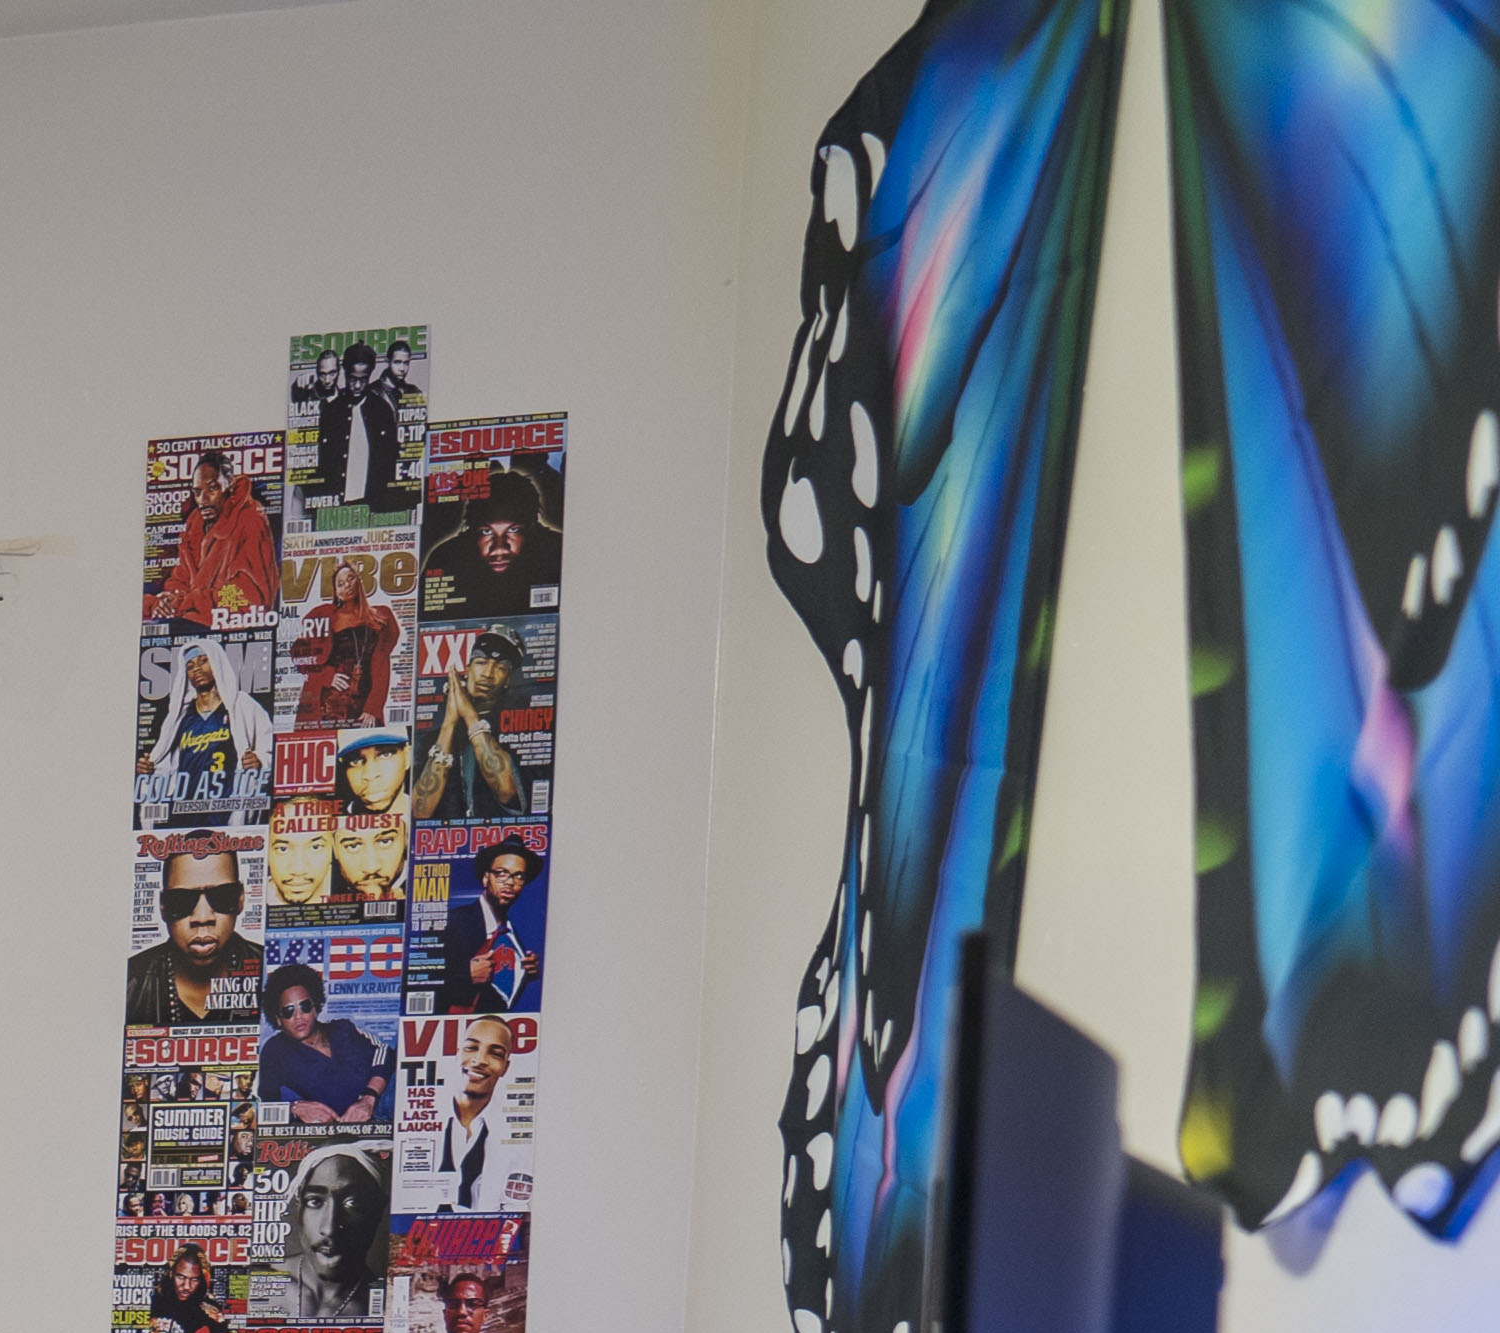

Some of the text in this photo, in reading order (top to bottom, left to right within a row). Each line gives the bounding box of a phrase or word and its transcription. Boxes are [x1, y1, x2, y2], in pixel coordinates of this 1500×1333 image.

[288, 402, 320, 417] BLACK
[398, 408, 426, 423] TUPAC
[156, 434, 275, 455] 50 CENT TALKS GREASY
[397, 427, 426, 447] Q-TIP
[439, 422, 564, 455] SOURCE
[161, 446, 284, 482] SORCE
[396, 463, 425, 482] E-40
[428, 469, 491, 490] KRS-ONE
[146, 490, 191, 505] SNOOP
[146, 502, 182, 516] DOGG
[316, 504, 371, 530] UNDER
[283, 530, 417, 551] SIXTH ANNIVERSARY JUICE ISSUE
[210, 605, 279, 631] Radio
[228, 630, 274, 643] NASH WADE
[500, 708, 555, 732] CHINGY
[180, 728, 231, 753] Nuggets
[210, 752, 226, 772] 3
[274, 740, 336, 786] HHC
[134, 768, 273, 805] COLD AS ICE
[173, 797, 269, 814] IVERSON STARTS FRESH
[274, 799, 344, 818] A TRIBE
[273, 813, 404, 835] CALLED QUEST
[415, 826, 468, 855] RAP
[413, 863, 451, 878] METHOD
[412, 877, 450, 902] MAN
[210, 976, 261, 994] KING OF
[328, 980, 402, 996] LENNY KRAVITZ
[204, 993, 259, 1011] AMERICA
[134, 1036, 260, 1067] SOURCE
[400, 1061, 445, 1087] T.I.
[407, 1087, 436, 1098] HAS
[407, 1099, 435, 1109] THE
[154, 1108, 225, 1128] SUMMER
[403, 1110, 438, 1121] LAST
[153, 1129, 225, 1142] MUSIC GUIDE
[258, 1124, 393, 1138] THE BEST ALBUMS & SONGS OF 2012
[397, 1122, 442, 1133] LAUGH
[254, 1169, 291, 1196] 50
[254, 1200, 290, 1222] HIP-
[116, 1223, 252, 1238] RISE OF THE BLOODS PG. 82
[253, 1222, 292, 1245] HOP
[124, 1237, 250, 1265] SOCE
[251, 1244, 286, 1259] SONGS
[113, 1274, 152, 1289] YOUNG
[112, 1289, 151, 1305] BUCK
[111, 1311, 151, 1326] CLIPSE
